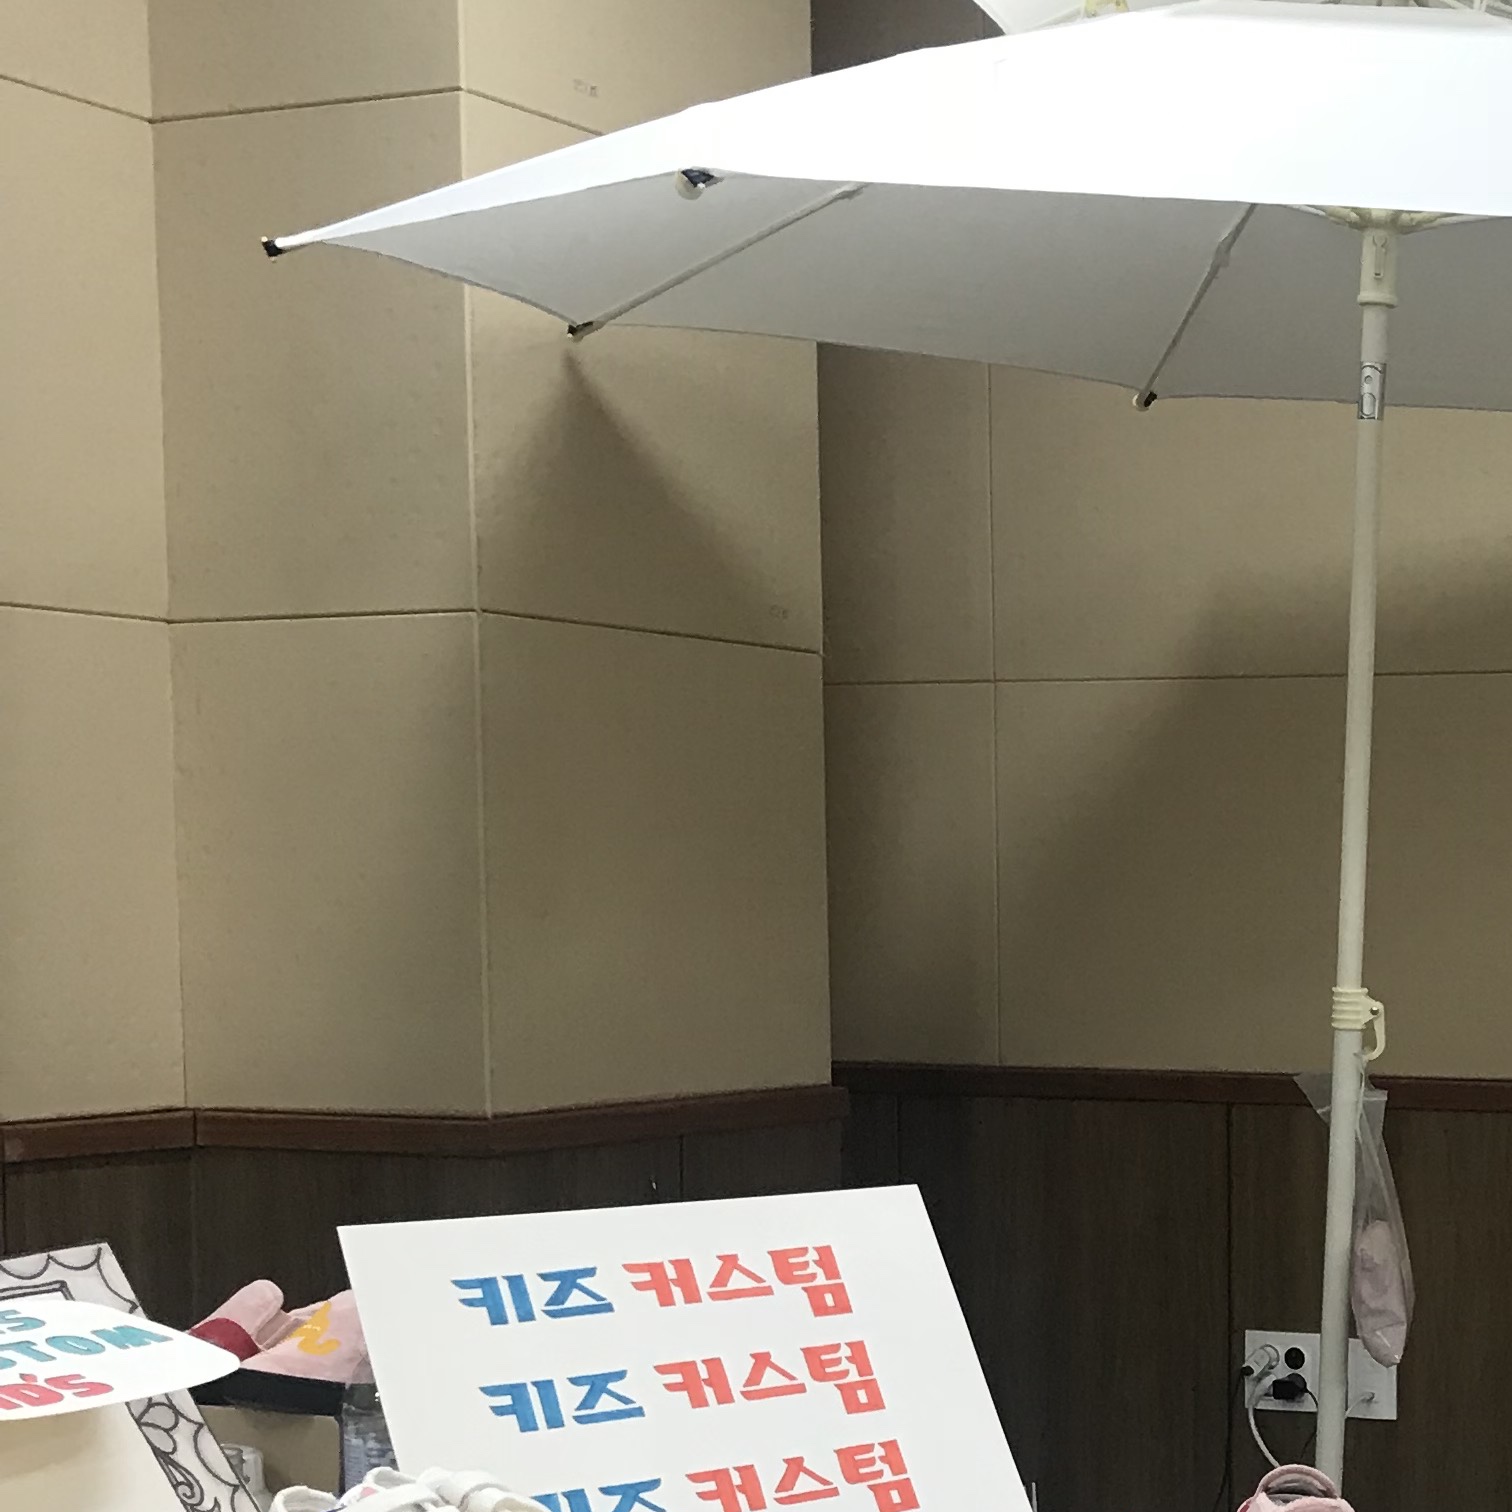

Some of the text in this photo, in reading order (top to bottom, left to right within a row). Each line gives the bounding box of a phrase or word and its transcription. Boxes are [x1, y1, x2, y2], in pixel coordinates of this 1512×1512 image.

[451, 1245, 853, 1327] 키즈 커스텀
[479, 1340, 886, 1433] 키즈 커스텀
